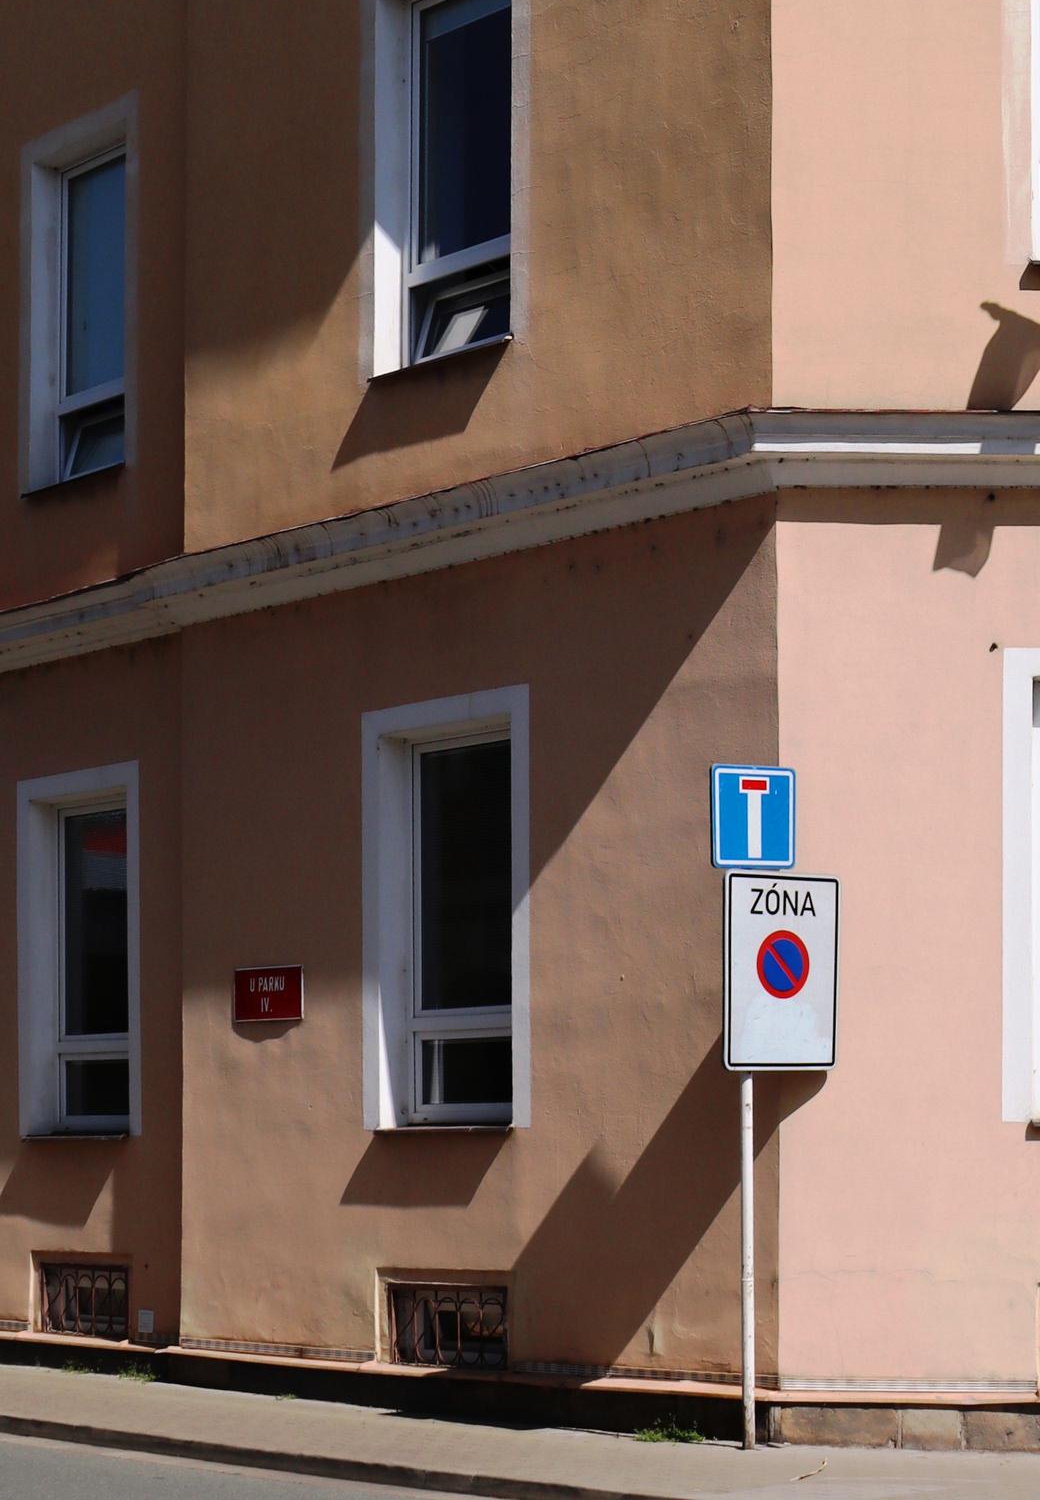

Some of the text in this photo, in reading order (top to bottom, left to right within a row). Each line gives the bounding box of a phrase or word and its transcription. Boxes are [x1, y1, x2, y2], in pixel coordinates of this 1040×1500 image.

[750, 883, 816, 917] ZÓNA
[249, 975, 285, 993] U PARKU
[261, 997, 273, 1013] IV.
